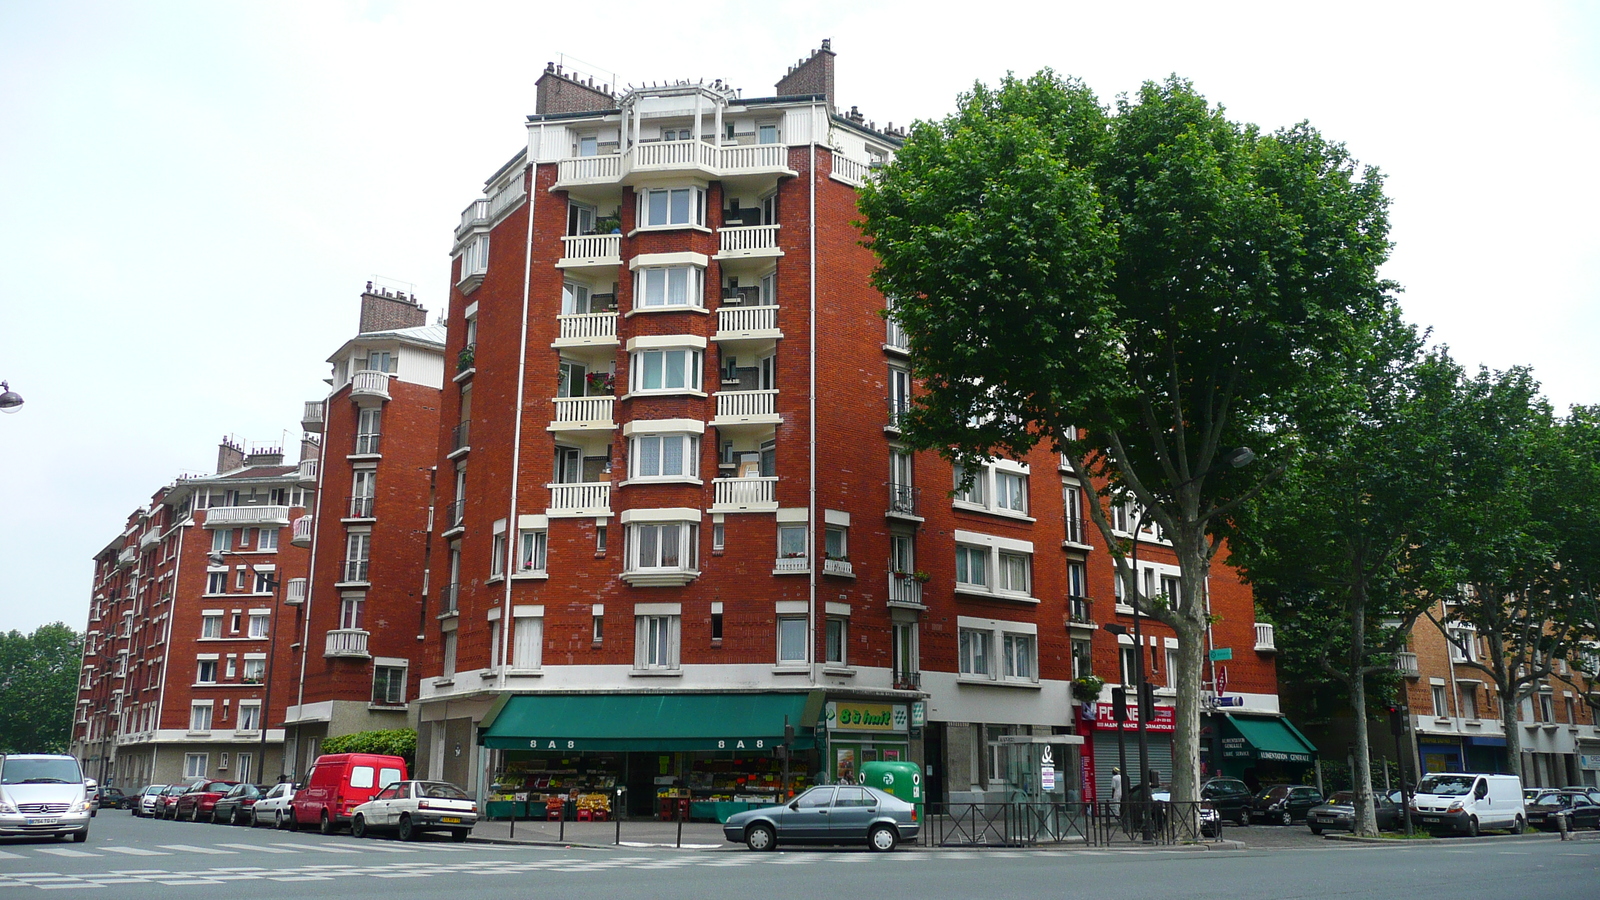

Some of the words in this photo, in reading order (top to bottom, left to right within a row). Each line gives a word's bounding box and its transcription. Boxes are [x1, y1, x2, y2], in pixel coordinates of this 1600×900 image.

[839, 708, 852, 725] 8
[852, 709, 862, 725] à
[862, 709, 891, 726] huit
[529, 739, 537, 748] 8
[547, 740, 557, 749] A
[567, 740, 575, 749] 8
[718, 740, 725, 749] 8
[736, 740, 745, 749] A
[756, 739, 764, 748] 8
[1260, 751, 1288, 760] ALIMENTATION
[1290, 754, 1310, 762] GENERALE
